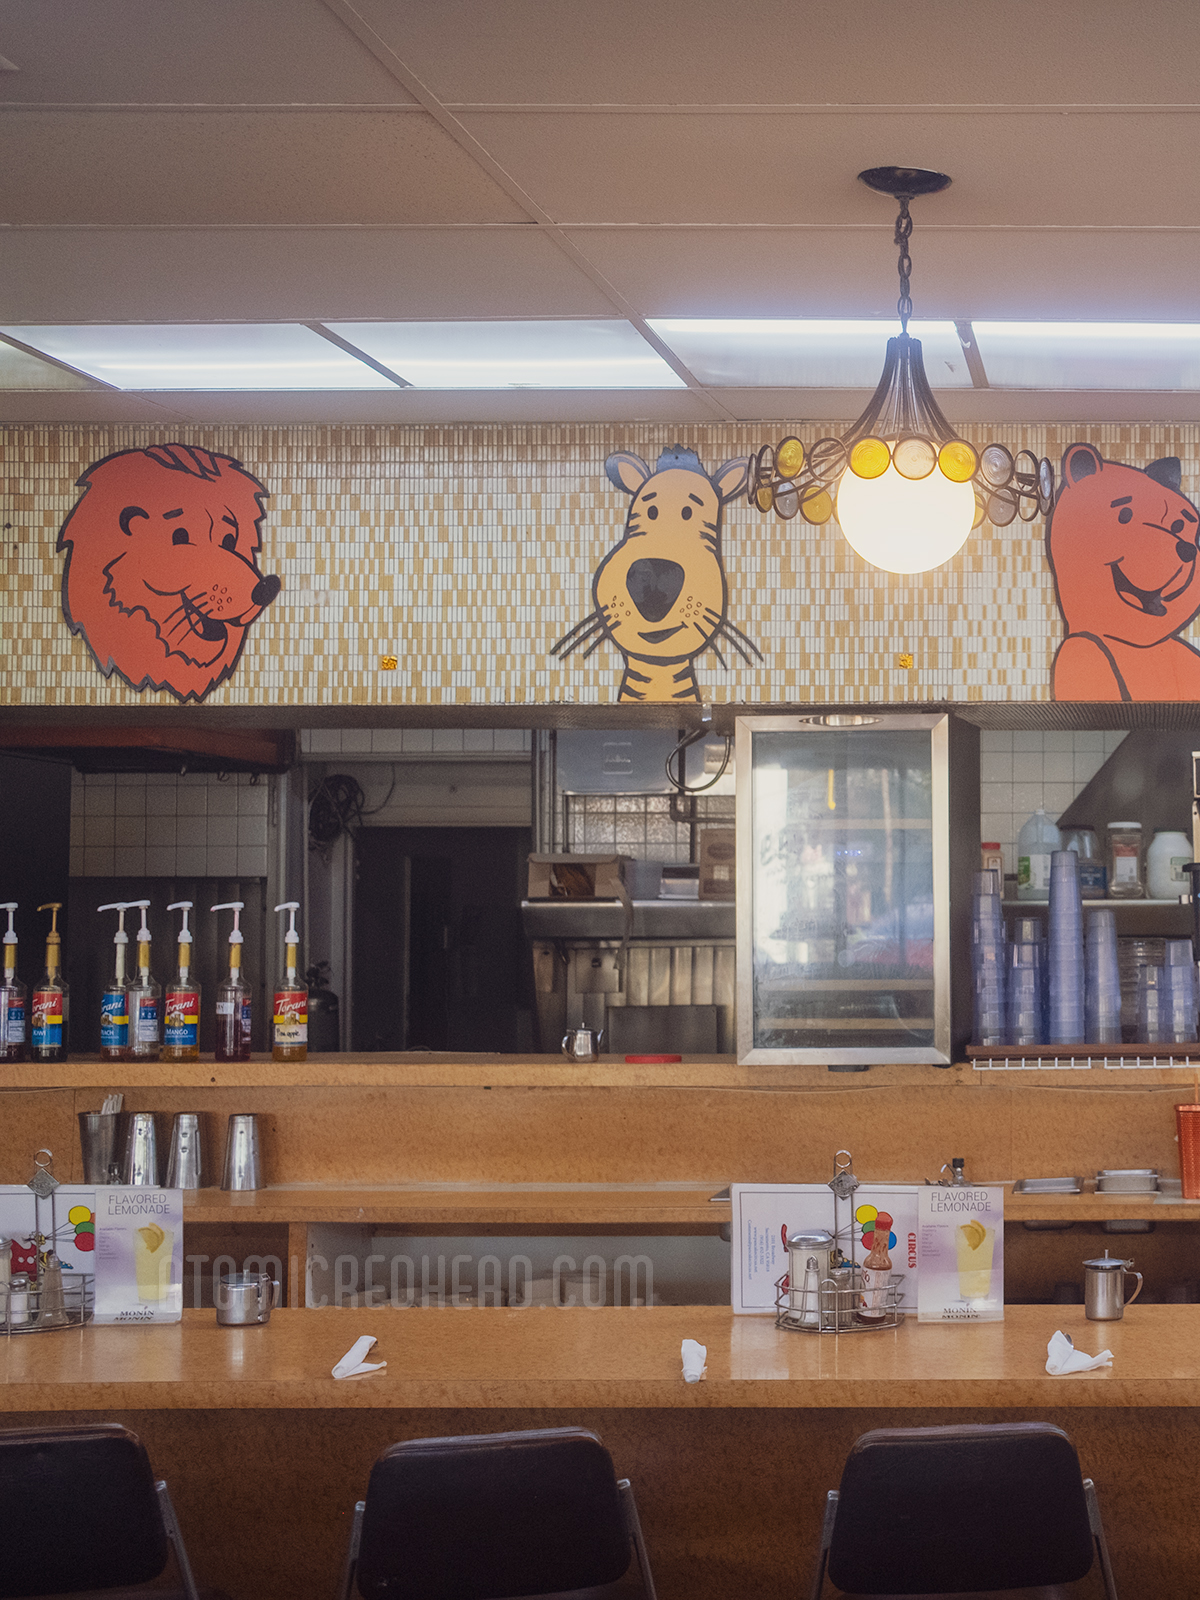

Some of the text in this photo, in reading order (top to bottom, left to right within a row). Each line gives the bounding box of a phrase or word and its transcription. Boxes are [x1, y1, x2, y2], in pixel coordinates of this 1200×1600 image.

[165, 997, 195, 1016] Torani
[275, 997, 307, 1016] Torani
[108, 1194, 167, 1205] FLAVORED
[931, 1191, 988, 1202] FLAVORED
[107, 1204, 171, 1216] LEMONADE
[930, 1202, 991, 1213] LEMONADE
[907, 1232, 917, 1269] CIRCUS
